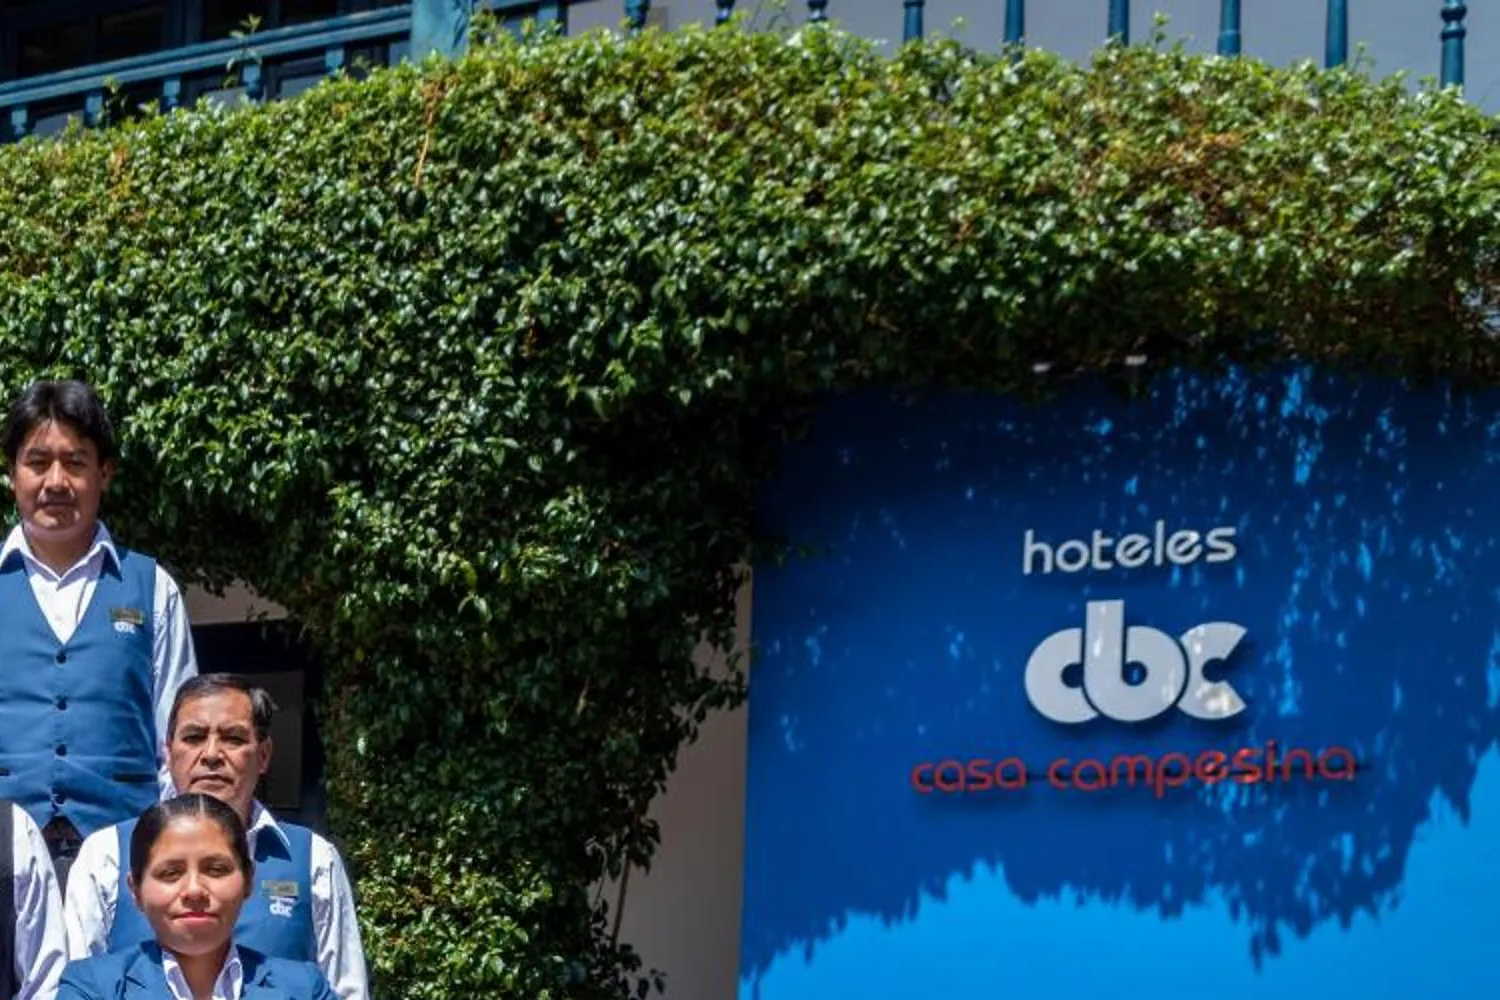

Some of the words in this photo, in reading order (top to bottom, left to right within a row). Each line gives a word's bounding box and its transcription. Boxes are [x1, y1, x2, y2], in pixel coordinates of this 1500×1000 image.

[1023, 520, 1237, 575] hoteles
[1024, 599, 1248, 724] cbc
[912, 756, 1027, 793] casa
[1048, 740, 1357, 798] campesina
